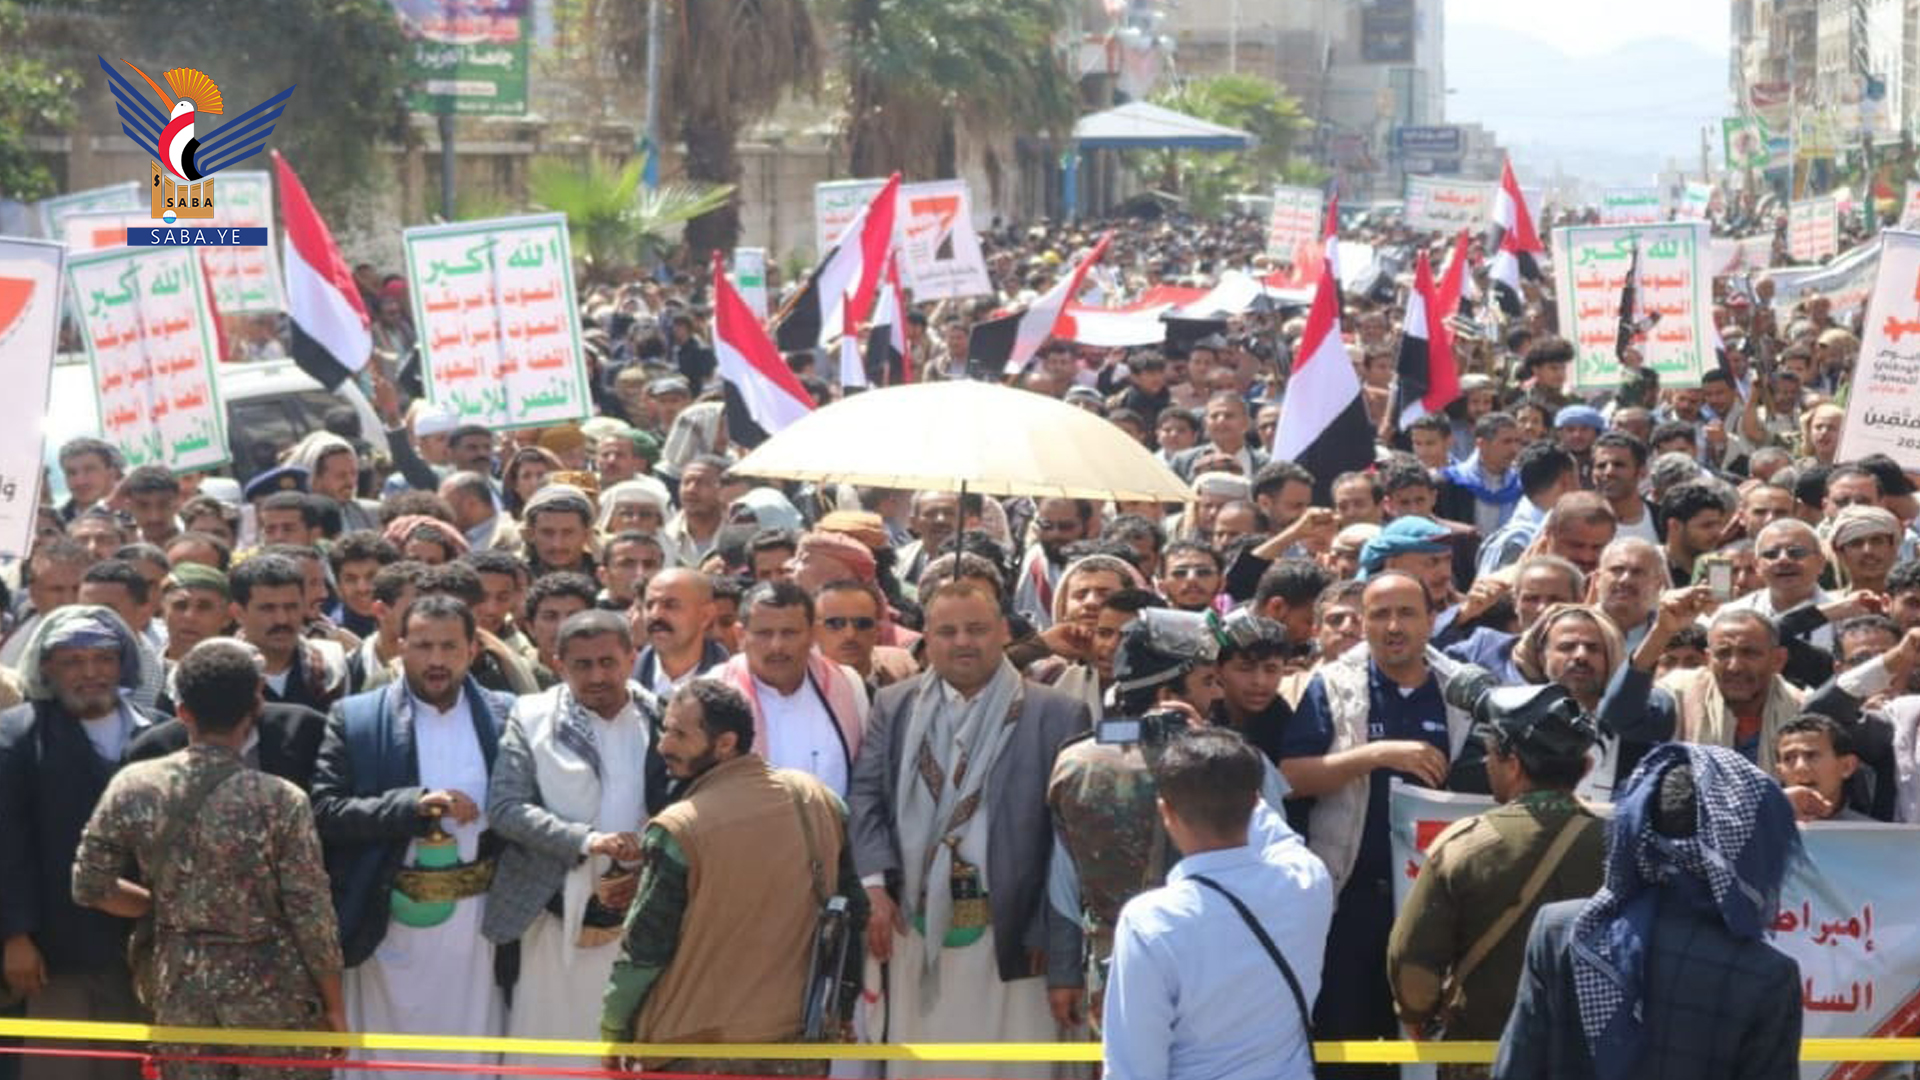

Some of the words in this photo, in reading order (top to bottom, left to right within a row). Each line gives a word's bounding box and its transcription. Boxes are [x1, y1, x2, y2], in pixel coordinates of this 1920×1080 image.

[423, 234, 499, 287] أكبر
[507, 236, 558, 267] الله
[1648, 234, 1691, 260] الله
[88, 259, 140, 319] أكبر
[151, 261, 191, 296] الله
[1652, 347, 1698, 372] النص
